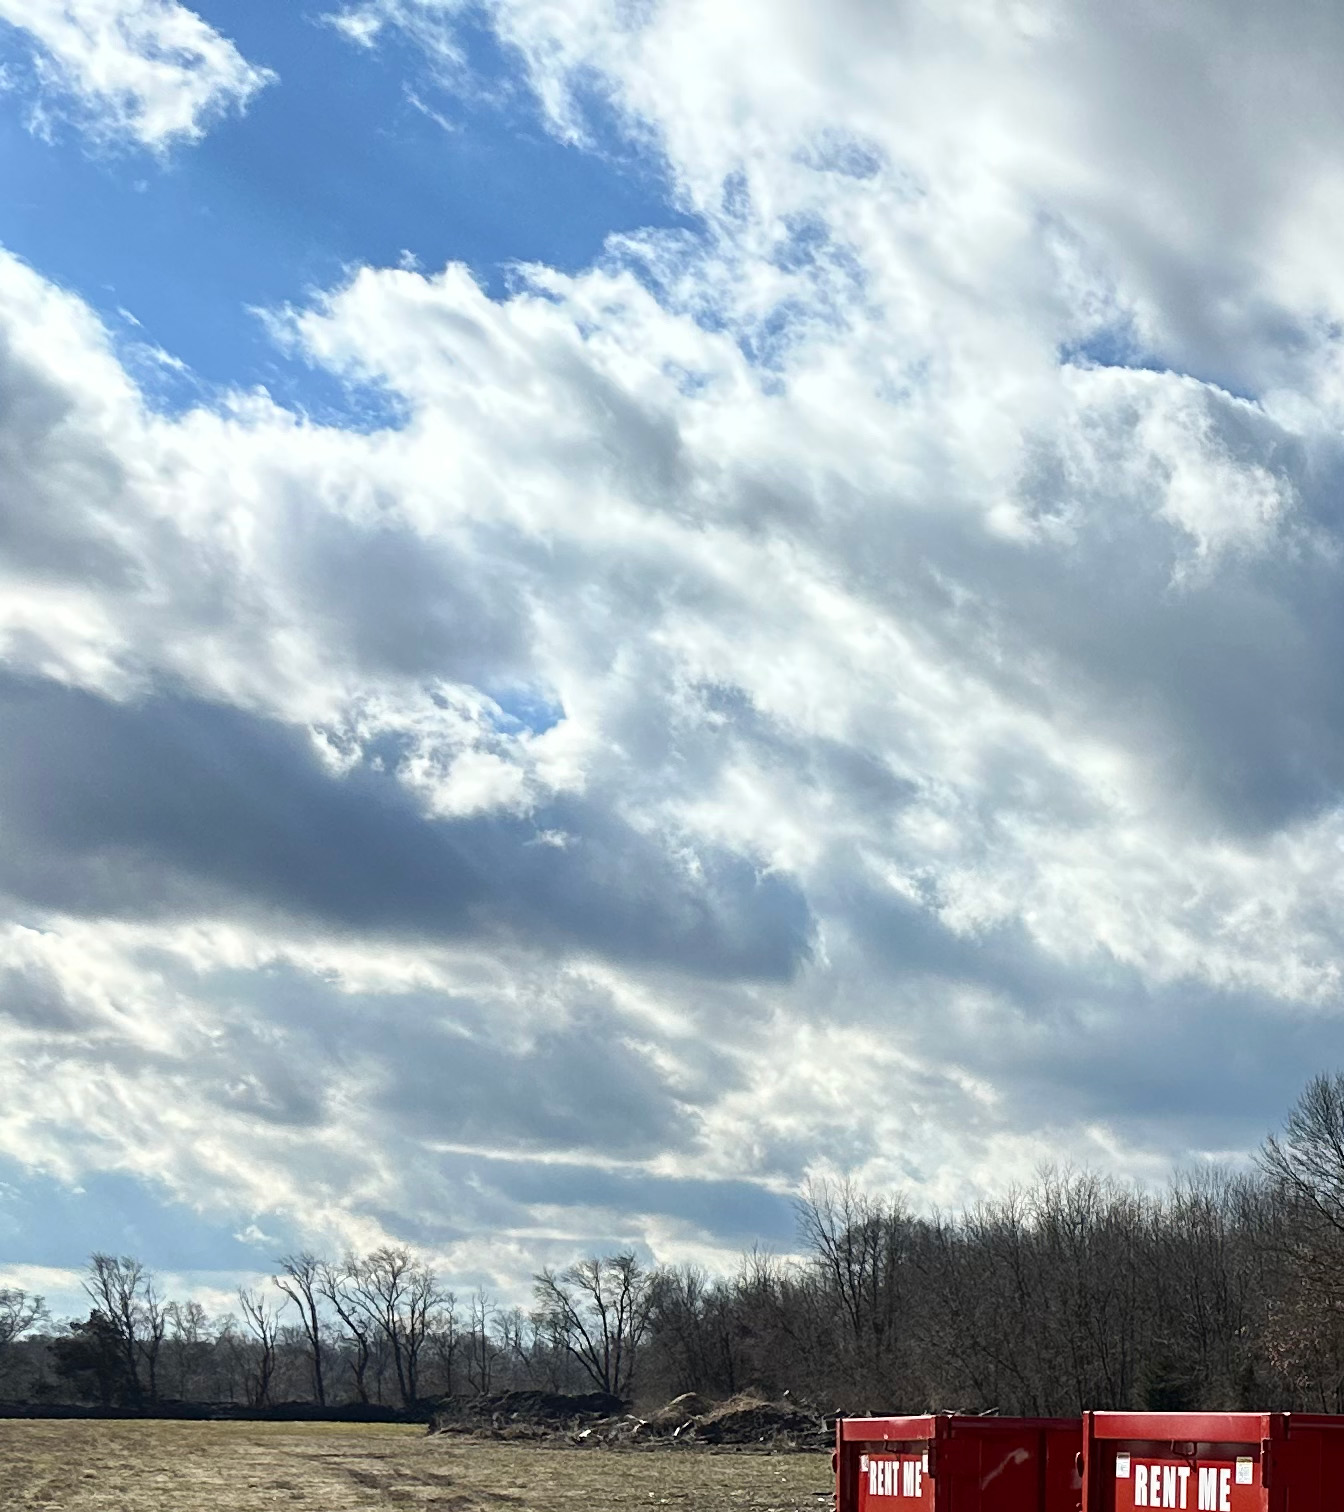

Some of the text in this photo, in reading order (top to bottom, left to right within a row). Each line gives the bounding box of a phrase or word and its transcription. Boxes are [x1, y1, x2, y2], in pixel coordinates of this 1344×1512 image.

[869, 1460, 922, 1497] RENT ME
[1134, 1464, 1190, 1509] RENT
[1198, 1467, 1231, 1512] ME
